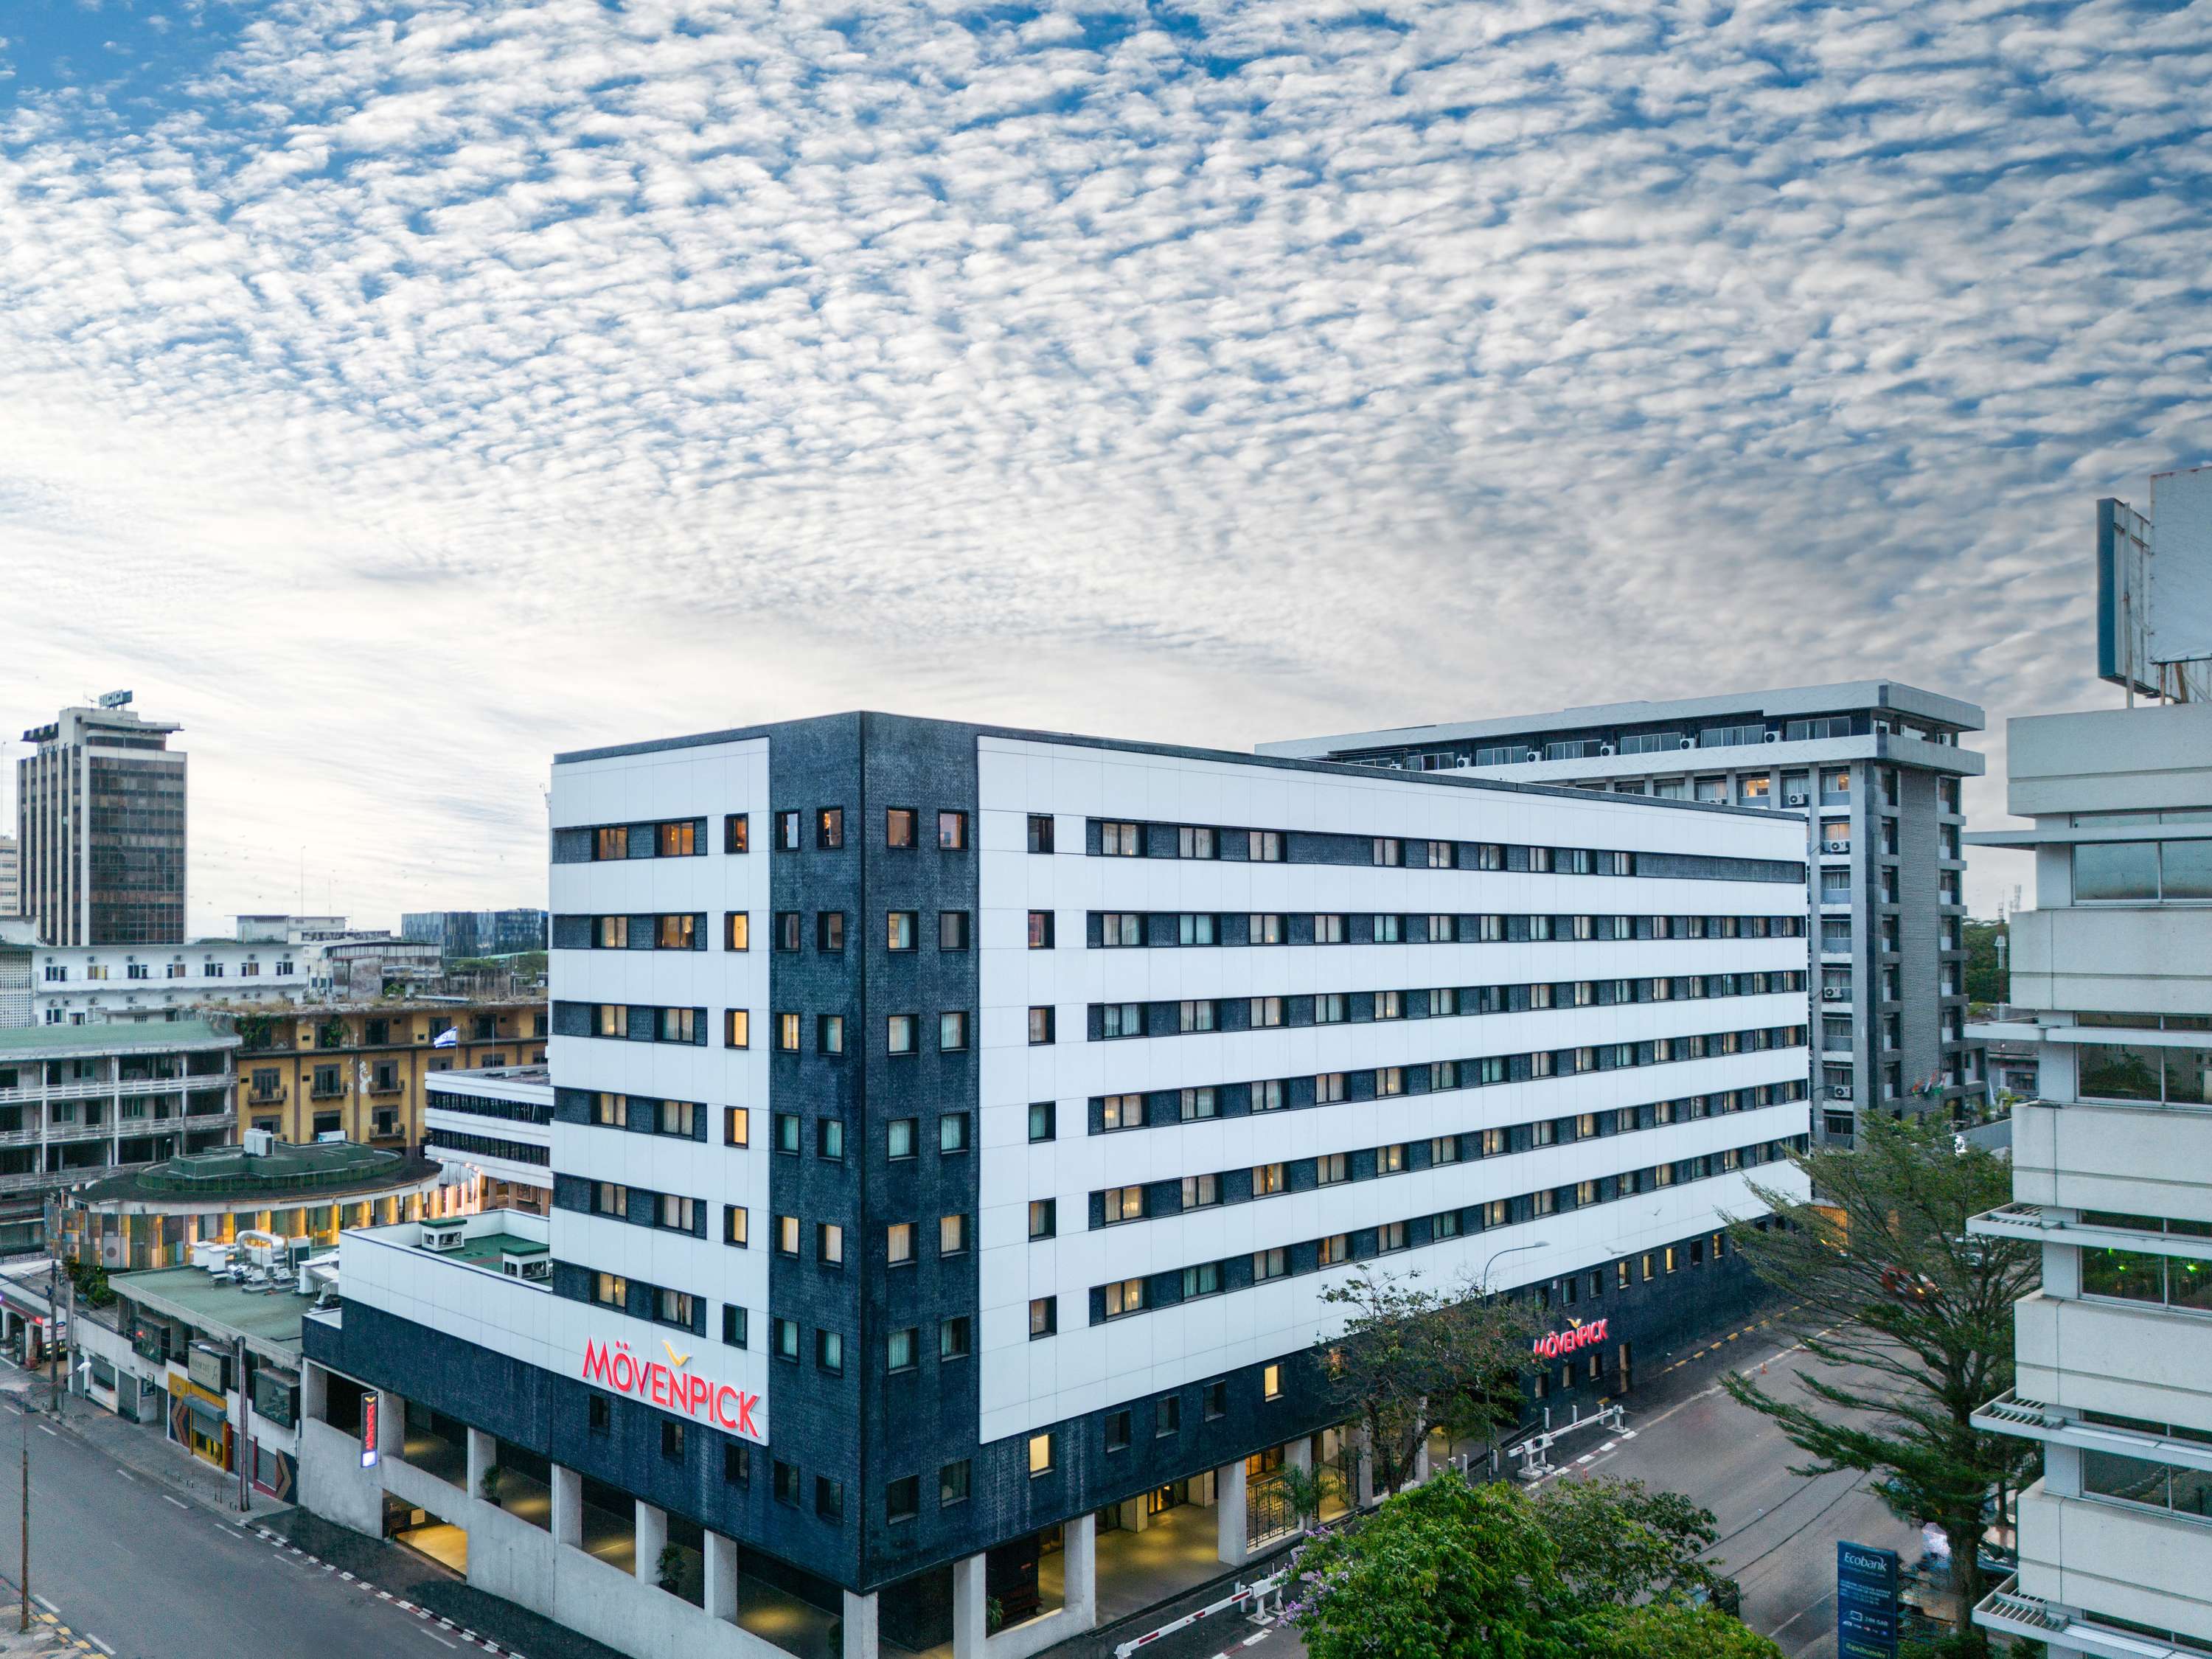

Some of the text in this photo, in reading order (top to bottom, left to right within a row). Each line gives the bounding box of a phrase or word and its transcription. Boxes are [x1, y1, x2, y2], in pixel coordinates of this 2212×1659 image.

[1533, 1318, 1608, 1358] MÖVENPICK
[582, 1337, 760, 1437] MÖVENPICK
[1844, 1552, 1888, 1572] Ecobank
